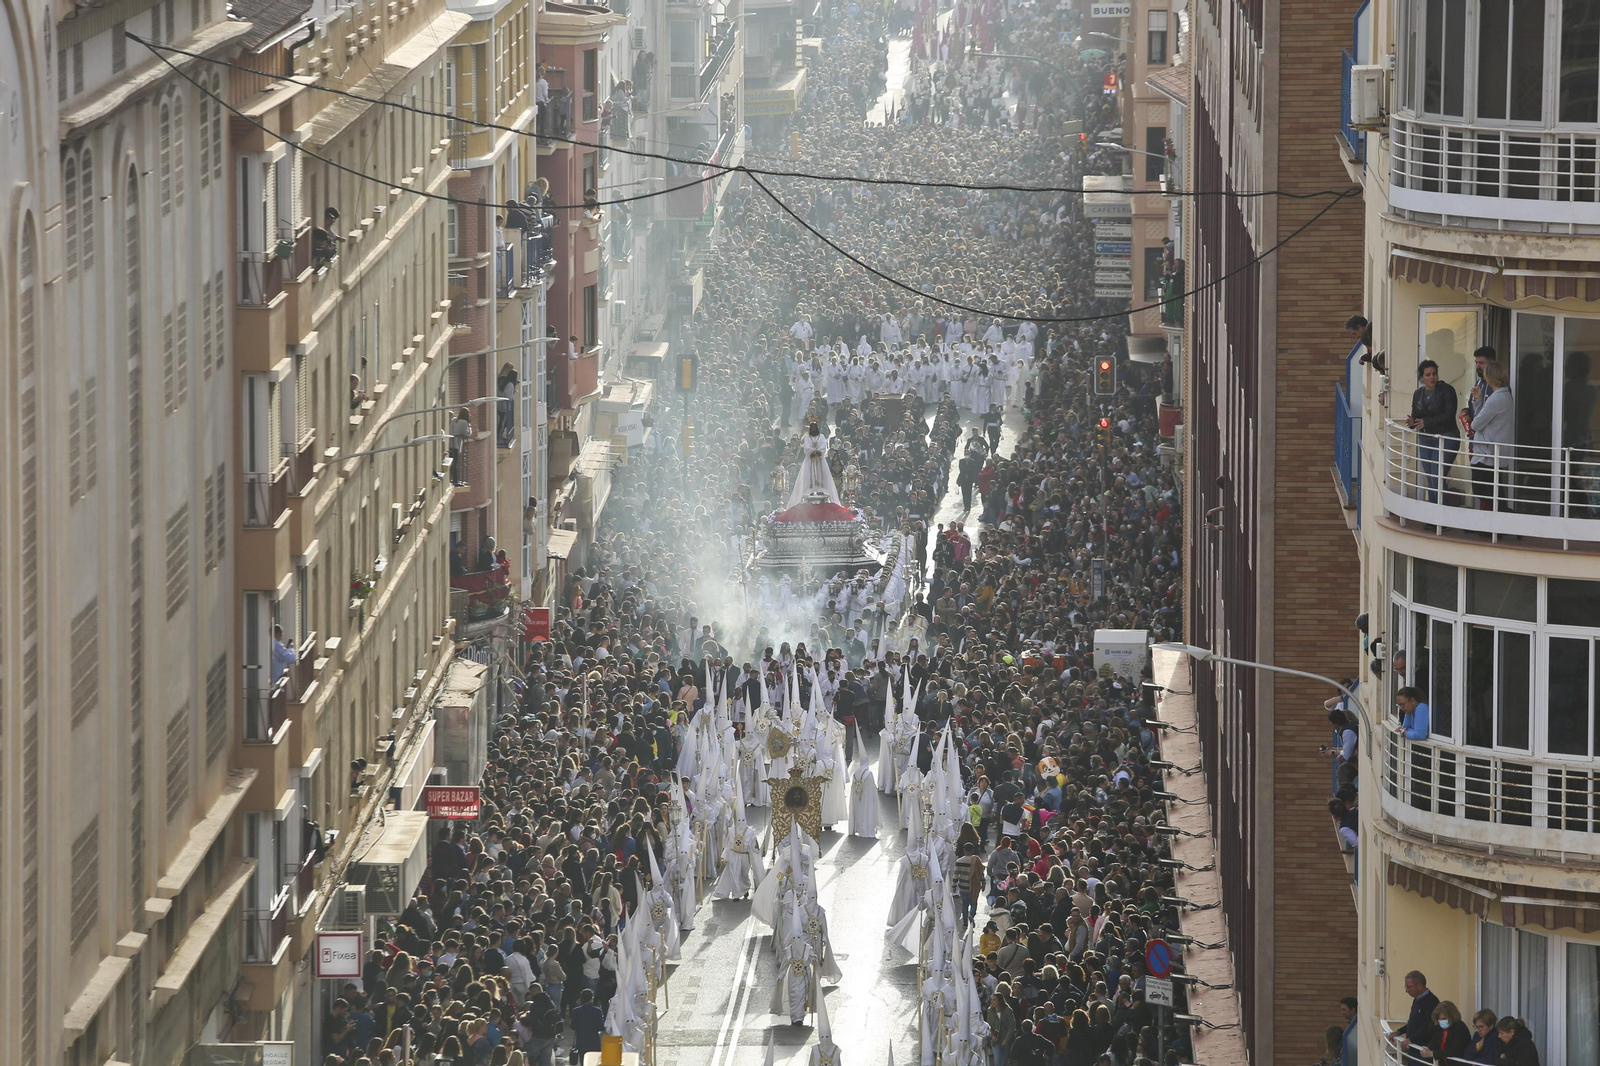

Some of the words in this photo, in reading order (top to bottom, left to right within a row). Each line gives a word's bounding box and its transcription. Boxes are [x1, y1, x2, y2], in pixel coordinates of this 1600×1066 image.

[428, 791, 450, 802] SUPER
[452, 791, 474, 802] BAZAR
[333, 951, 356, 960] Fixea
